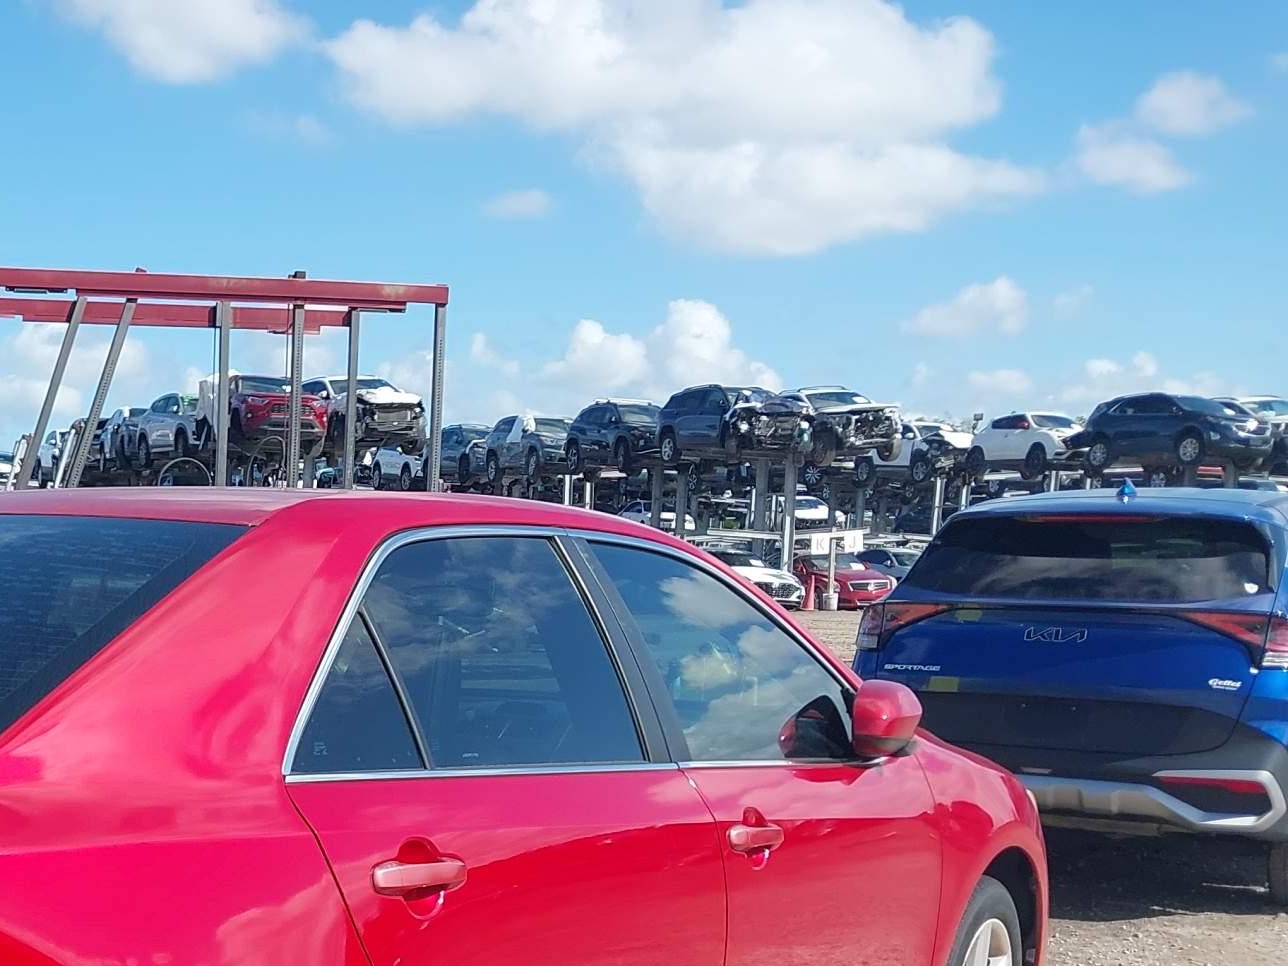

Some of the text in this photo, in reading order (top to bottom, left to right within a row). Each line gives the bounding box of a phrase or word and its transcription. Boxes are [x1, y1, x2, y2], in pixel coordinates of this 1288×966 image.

[816, 538, 825, 551] K
[1024, 626, 1088, 642] KIA
[883, 663, 941, 672] SPORTAGE
